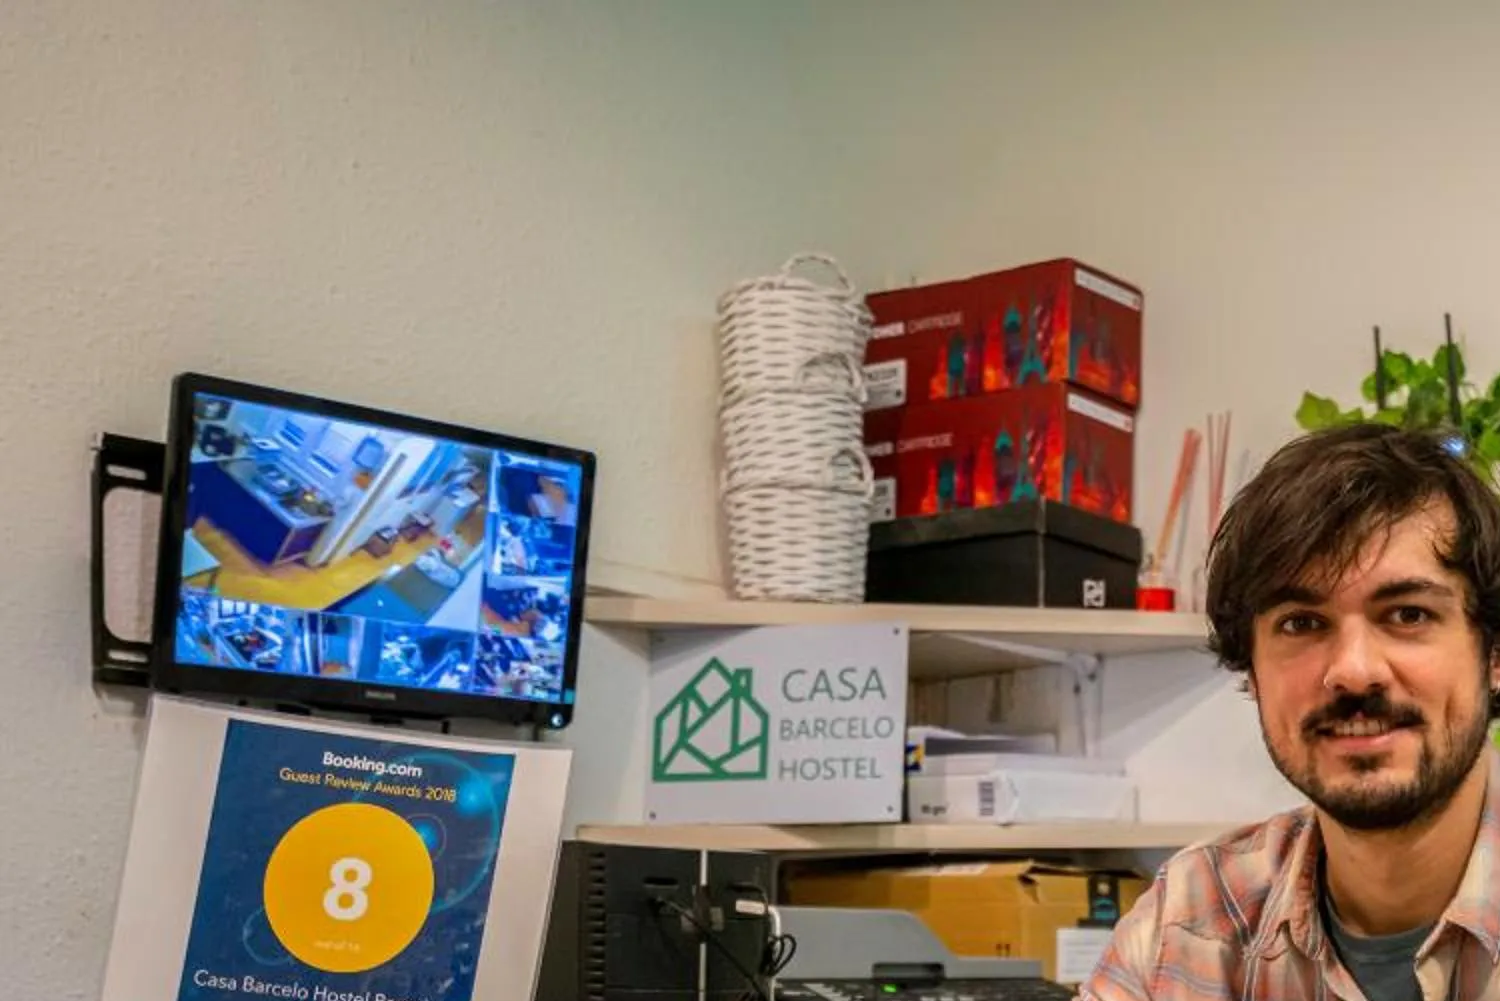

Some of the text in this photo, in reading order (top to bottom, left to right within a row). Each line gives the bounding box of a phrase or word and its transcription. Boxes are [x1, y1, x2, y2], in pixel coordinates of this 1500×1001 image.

[782, 667, 887, 703] CASA
[779, 715, 895, 740] BARCELO
[323, 751, 423, 778] Booking.com
[779, 756, 883, 781] HOSTEL
[279, 767, 456, 803] Guest Review Awards 2018
[322, 856, 373, 922] 8
[193, 969, 238, 991] Casa
[242, 975, 309, 1000] Barcelo
